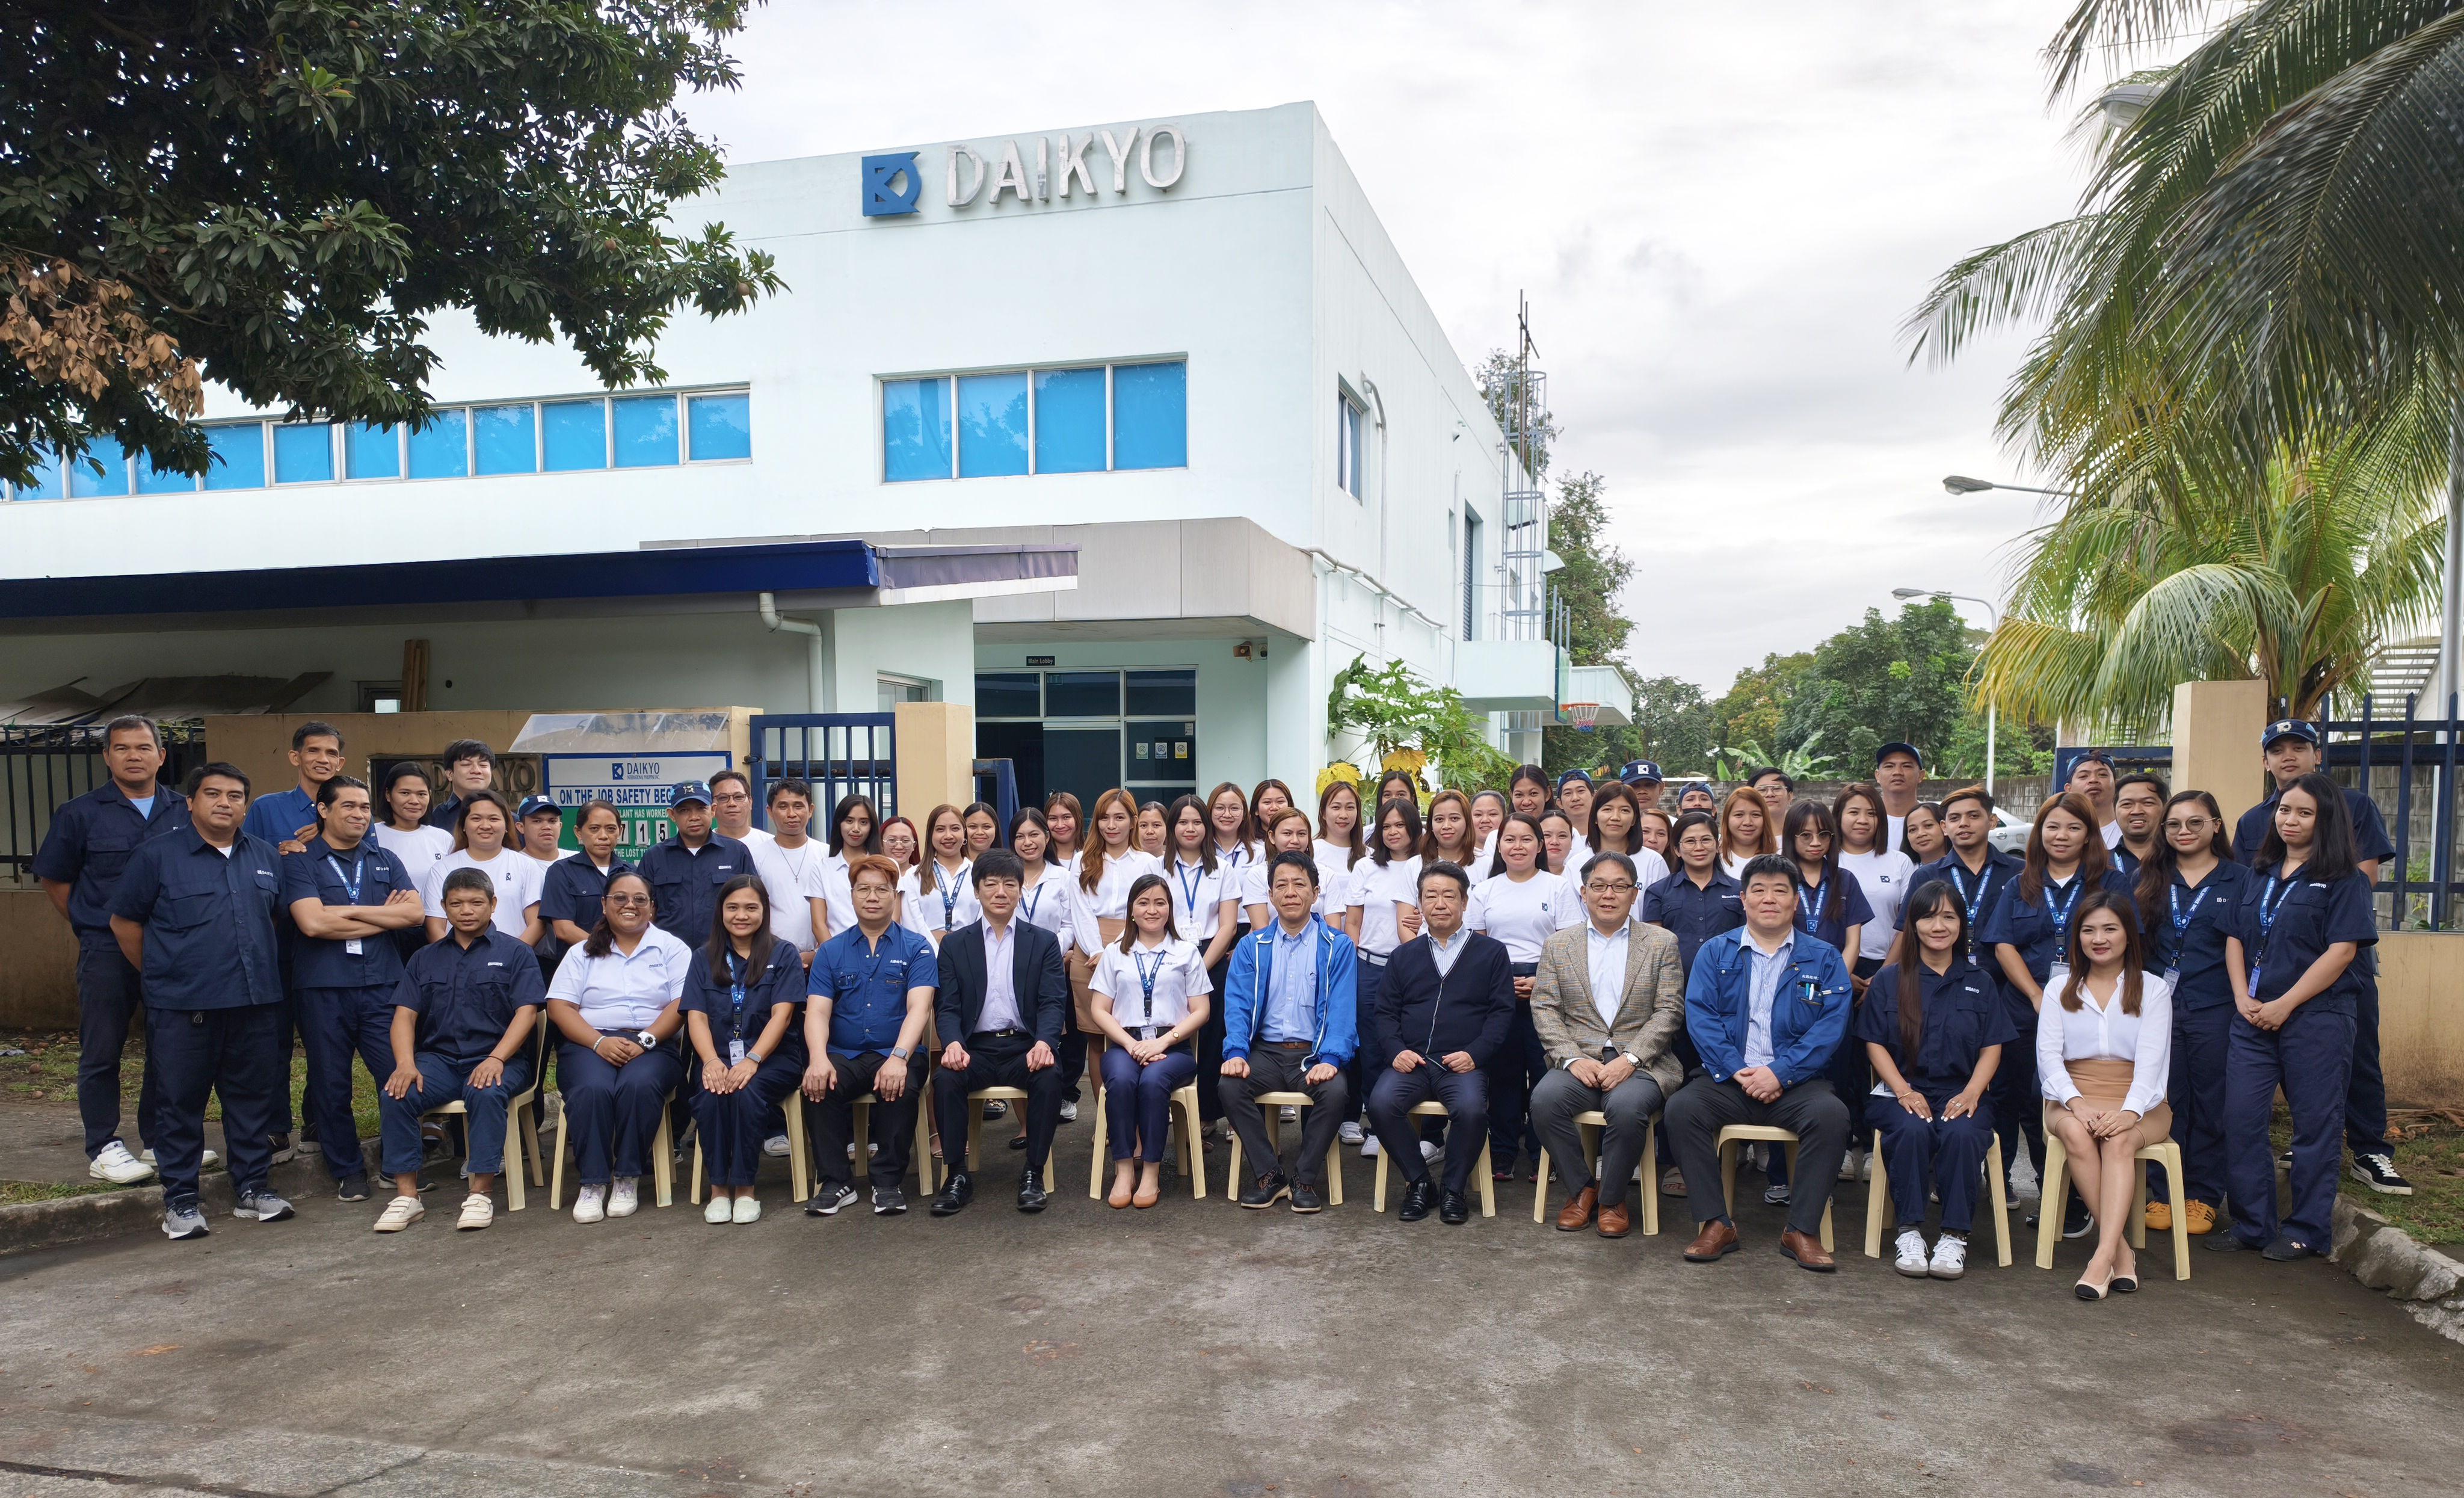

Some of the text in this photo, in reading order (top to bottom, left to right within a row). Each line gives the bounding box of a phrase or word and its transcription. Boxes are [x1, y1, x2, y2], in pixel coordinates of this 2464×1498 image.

[947, 124, 1186, 208] DAIKYO
[627, 762, 660, 775] DAIKYO
[559, 789, 572, 804] ON
[575, 789, 593, 804] THE
[617, 789, 651, 804] SAFETY
[618, 809, 633, 818] LANT
[634, 809, 645, 818] HAS
[626, 848, 639, 857] LOST
